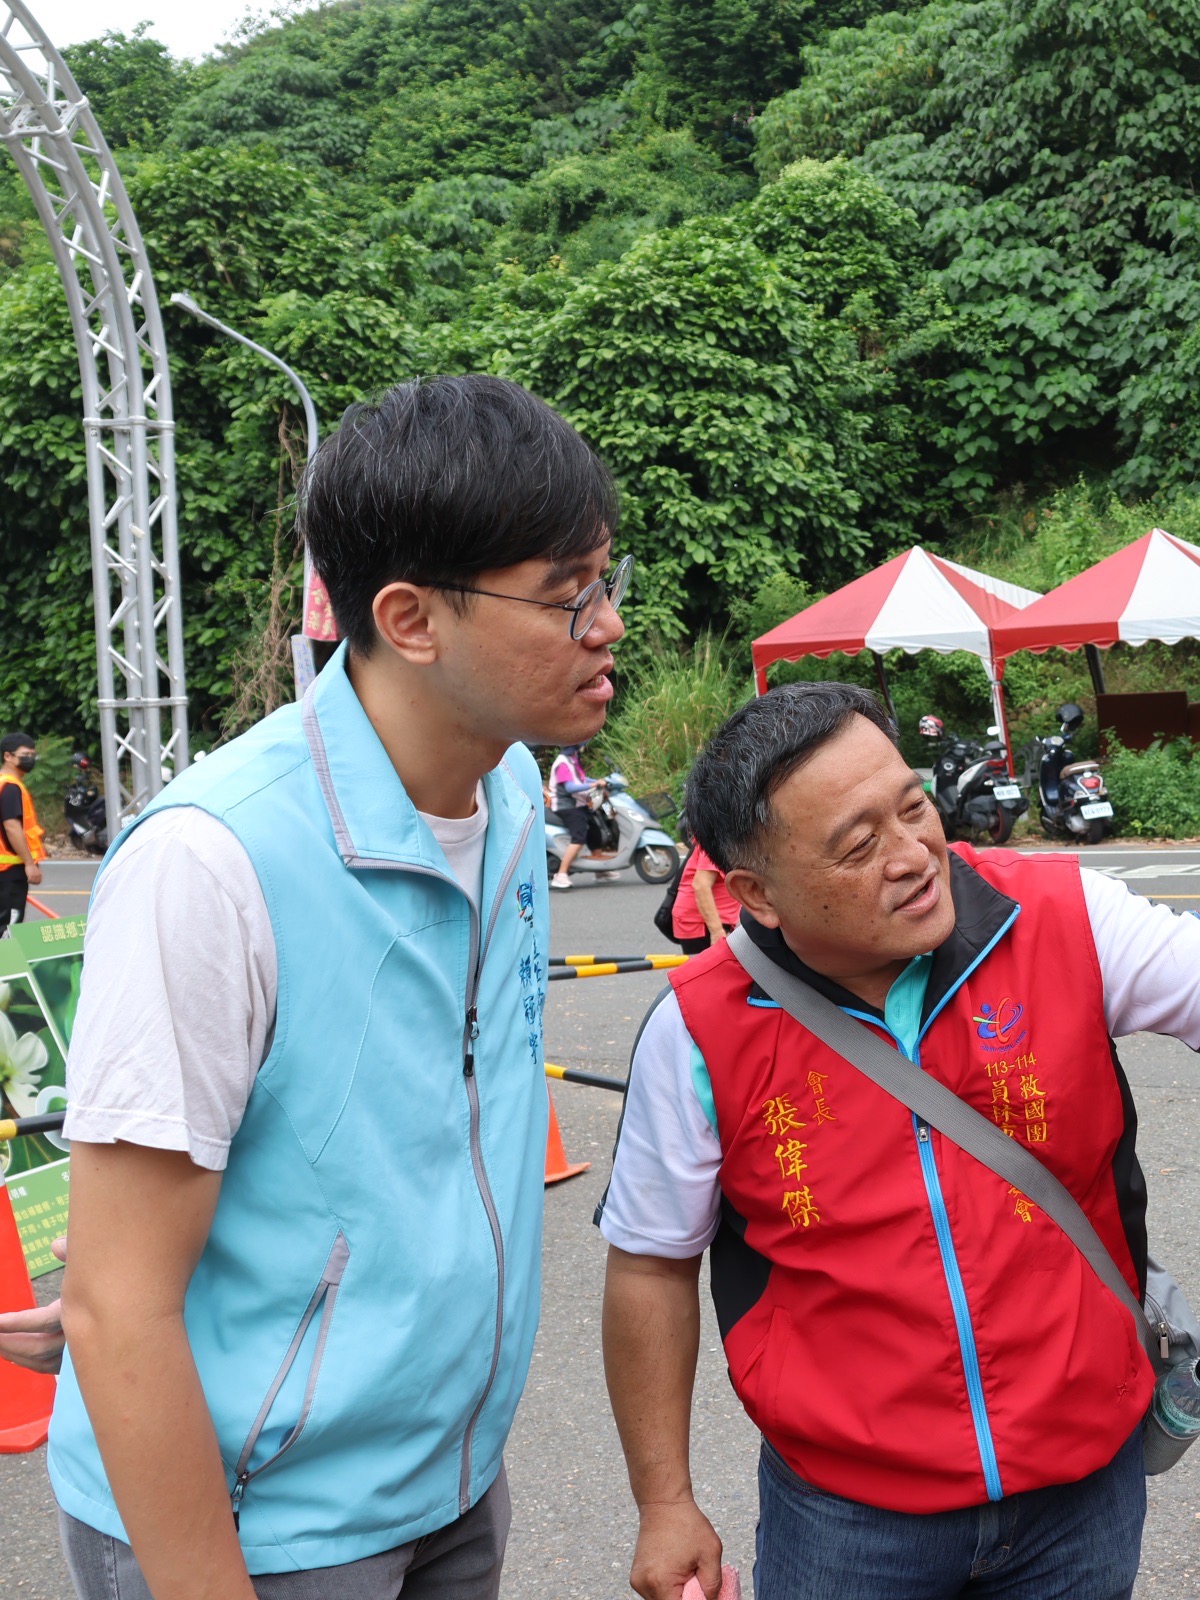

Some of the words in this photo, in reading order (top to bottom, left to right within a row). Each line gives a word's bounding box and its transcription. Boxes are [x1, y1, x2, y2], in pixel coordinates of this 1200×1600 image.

[984, 1051, 1037, 1078] 113-114
[805, 1070, 837, 1126] 會長
[1019, 1073, 1047, 1143] 救國團
[762, 1092, 821, 1229] 張偉傑
